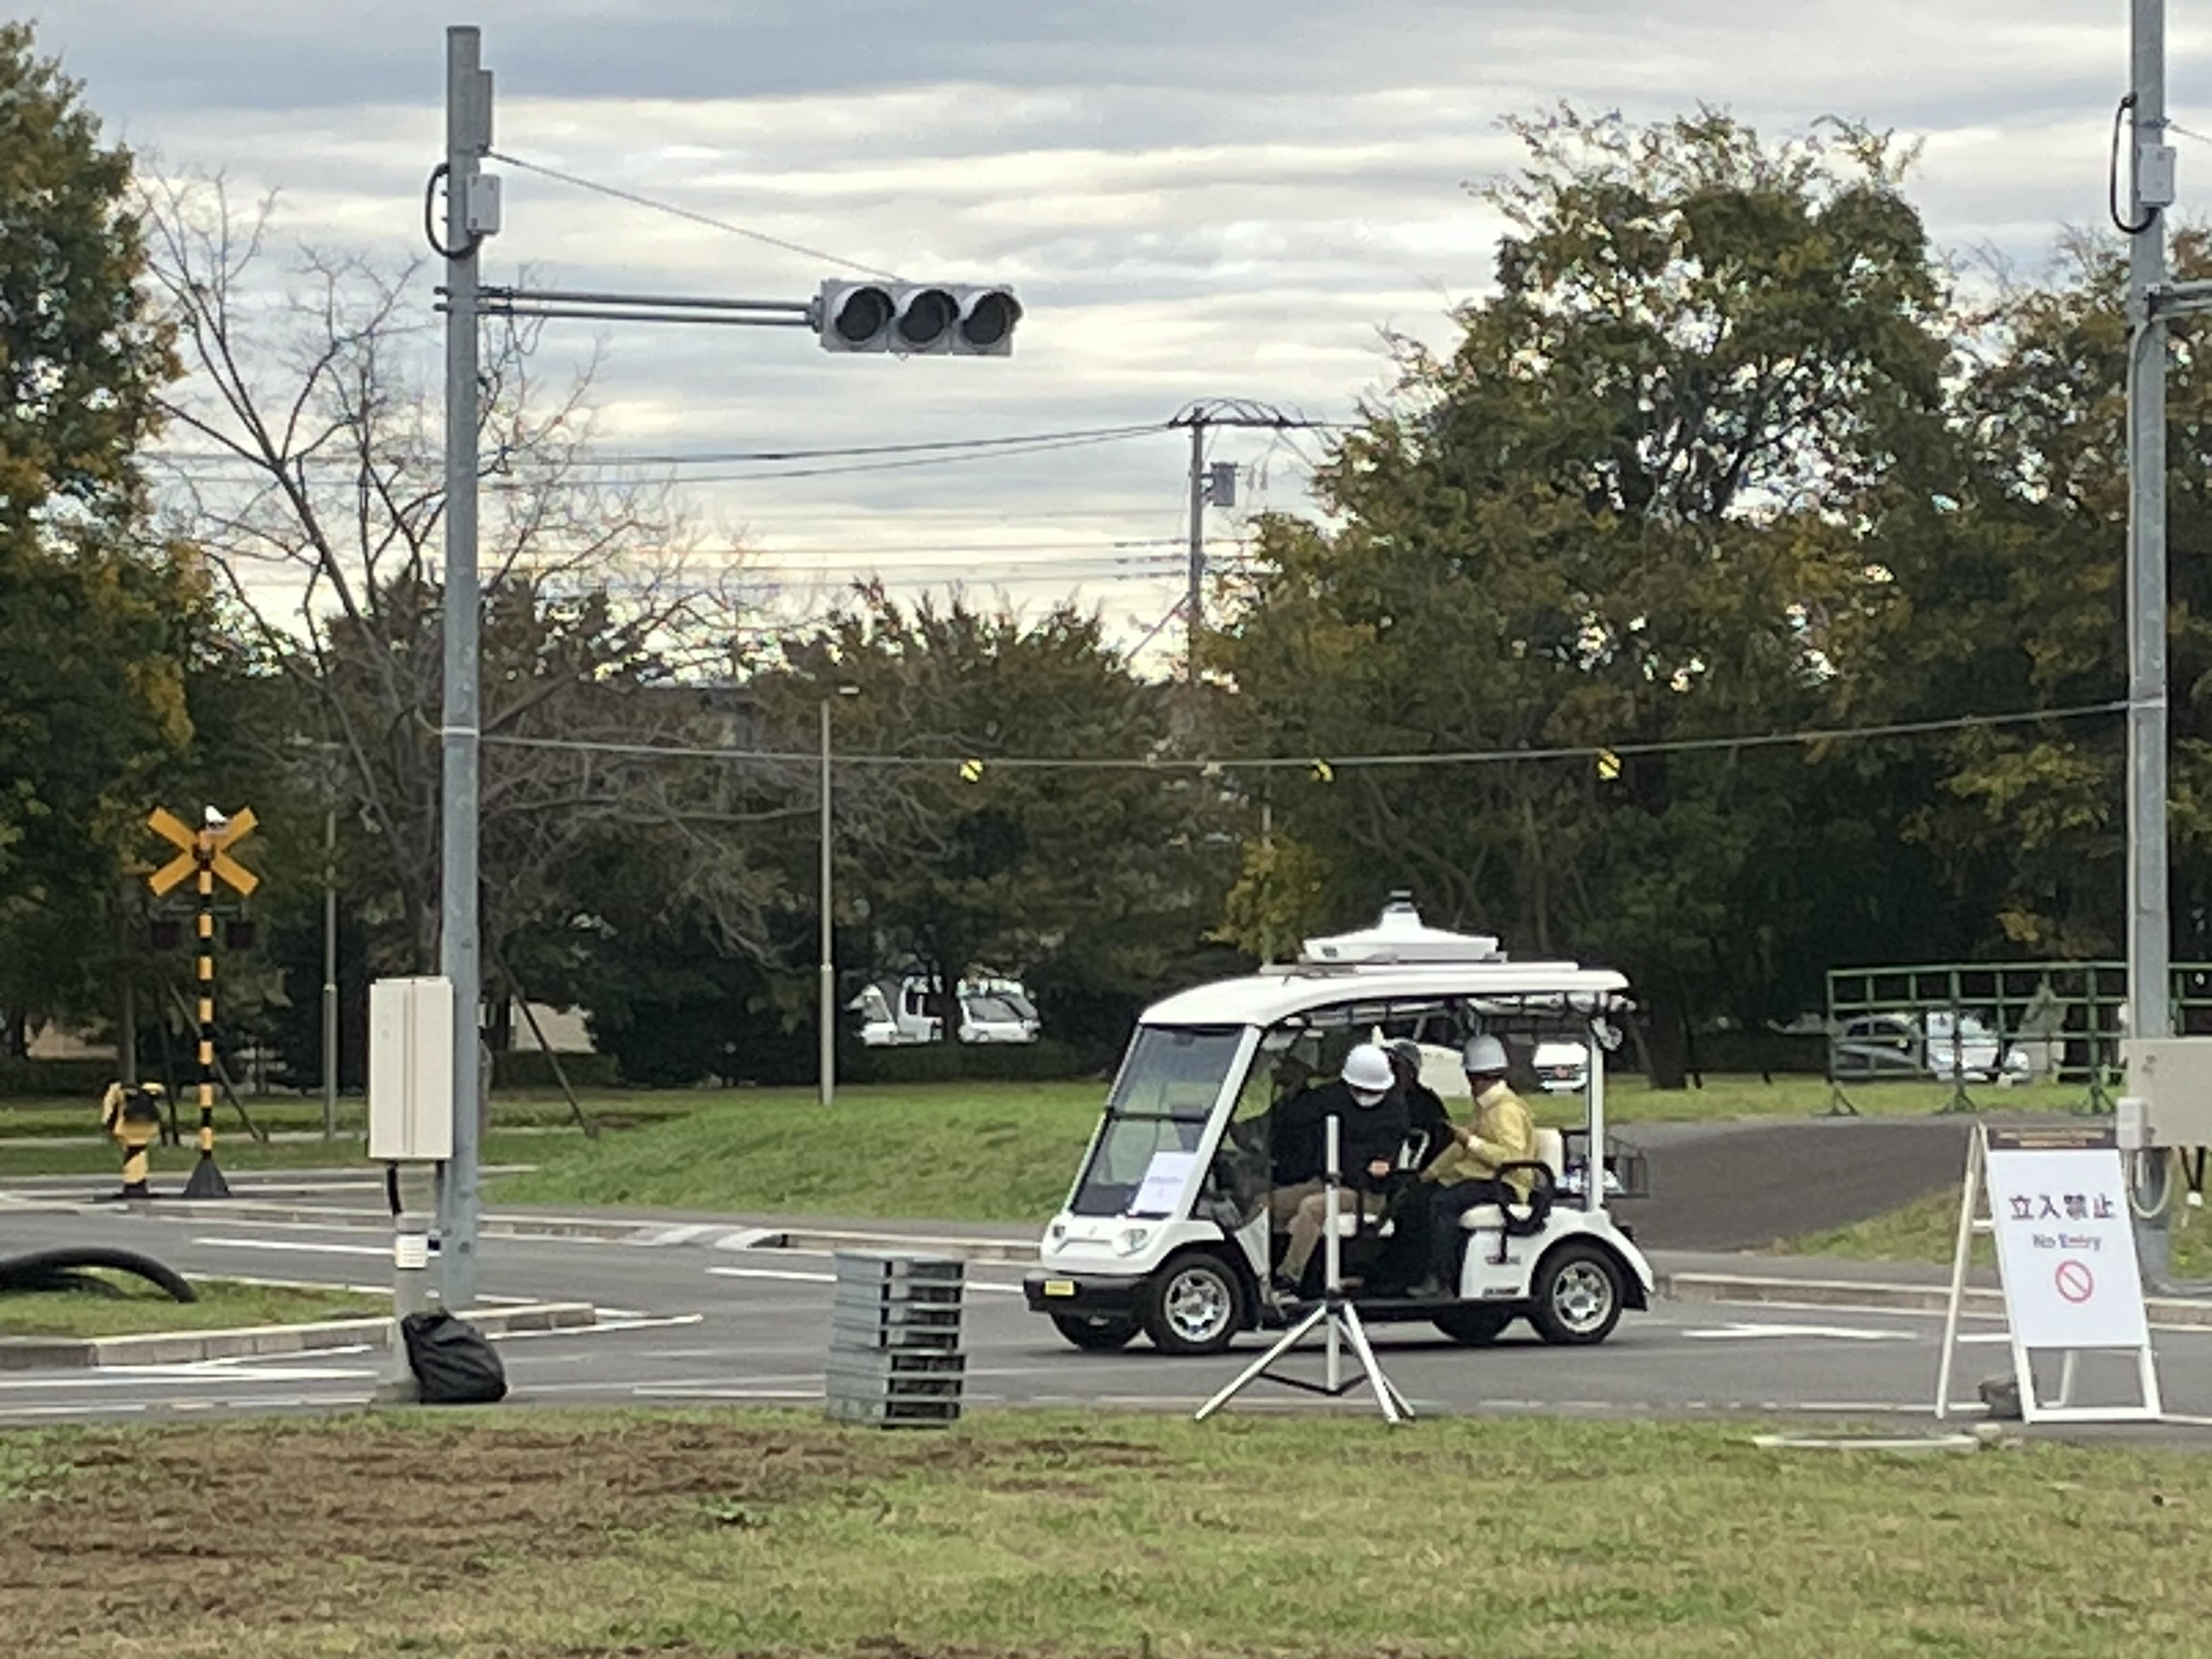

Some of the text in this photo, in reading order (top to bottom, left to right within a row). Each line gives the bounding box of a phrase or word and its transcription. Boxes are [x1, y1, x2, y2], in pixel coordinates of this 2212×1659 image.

[2008, 1193, 2117, 1221] 立入禁止
[2033, 1234, 2056, 1249] No
